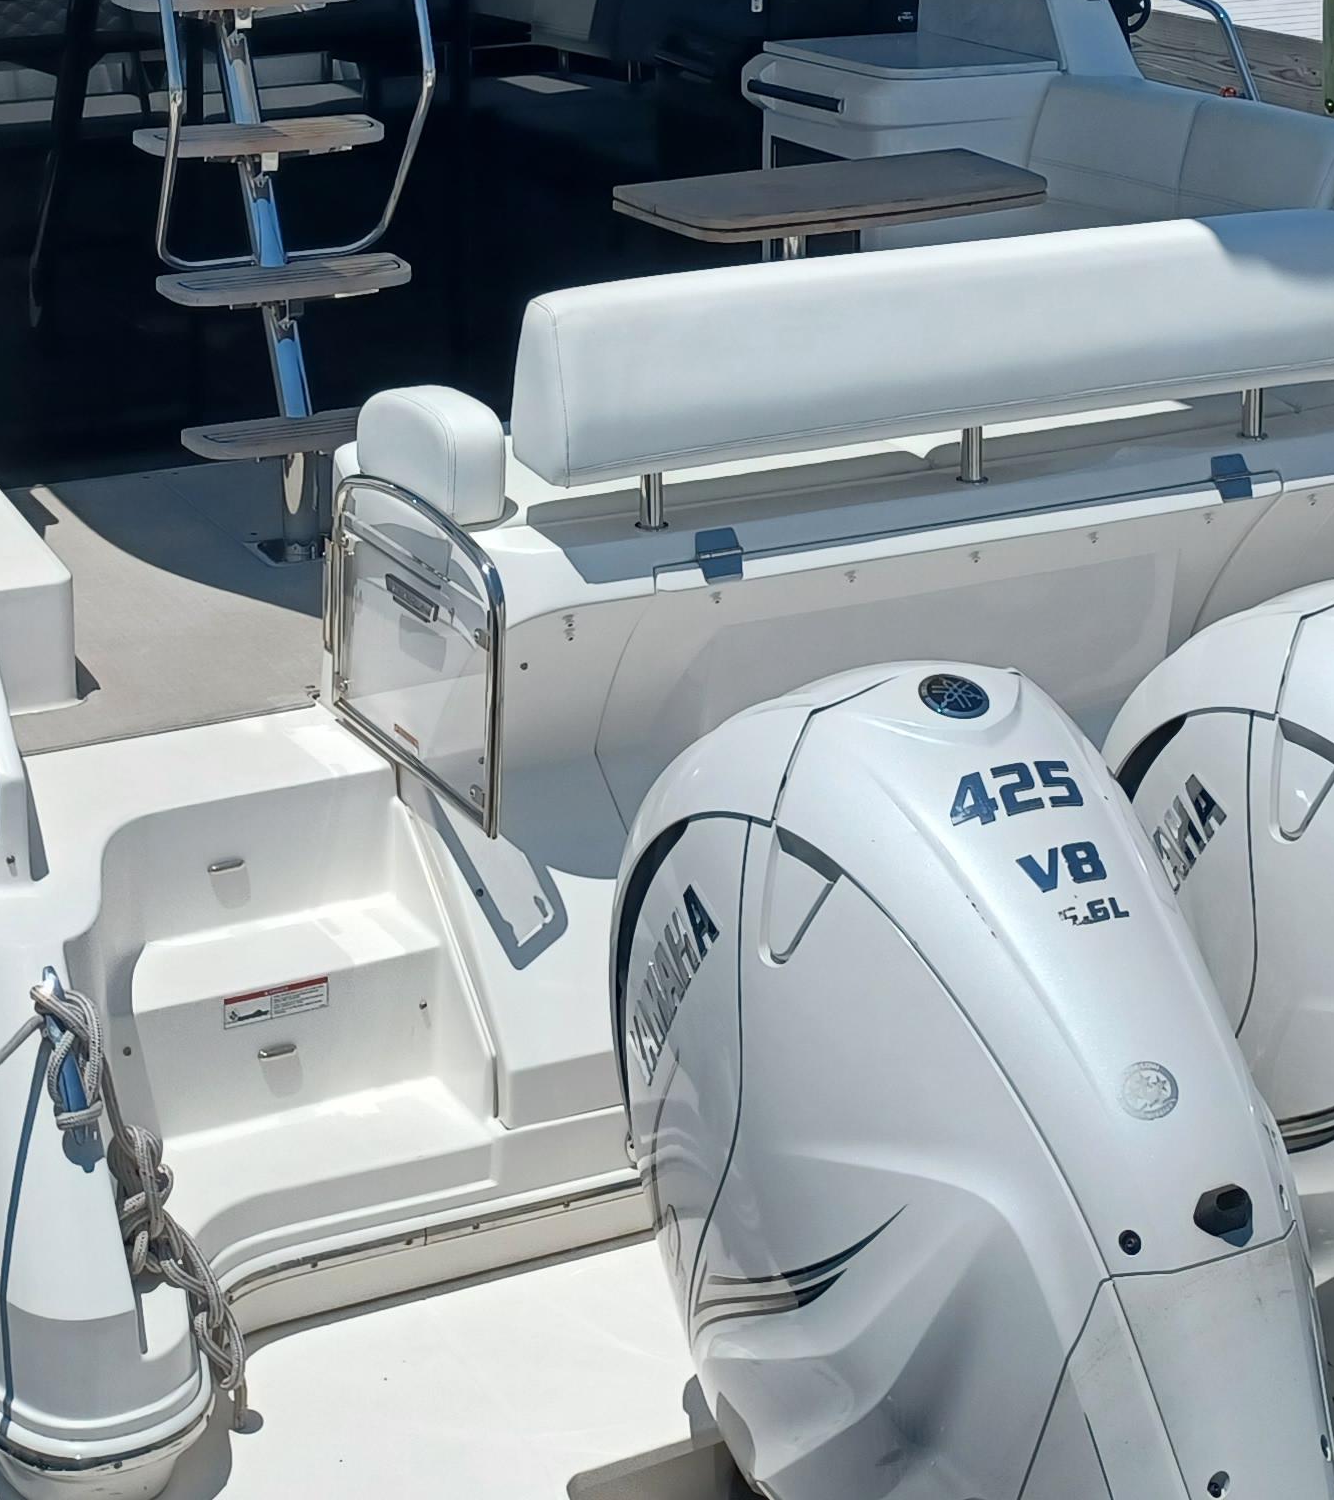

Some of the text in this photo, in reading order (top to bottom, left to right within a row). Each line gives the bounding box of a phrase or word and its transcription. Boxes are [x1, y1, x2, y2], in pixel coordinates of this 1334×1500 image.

[950, 760, 1084, 826] 425
[1153, 773, 1227, 894] AHA
[1016, 841, 1108, 893] V8
[629, 884, 720, 1086] YAMAHA
